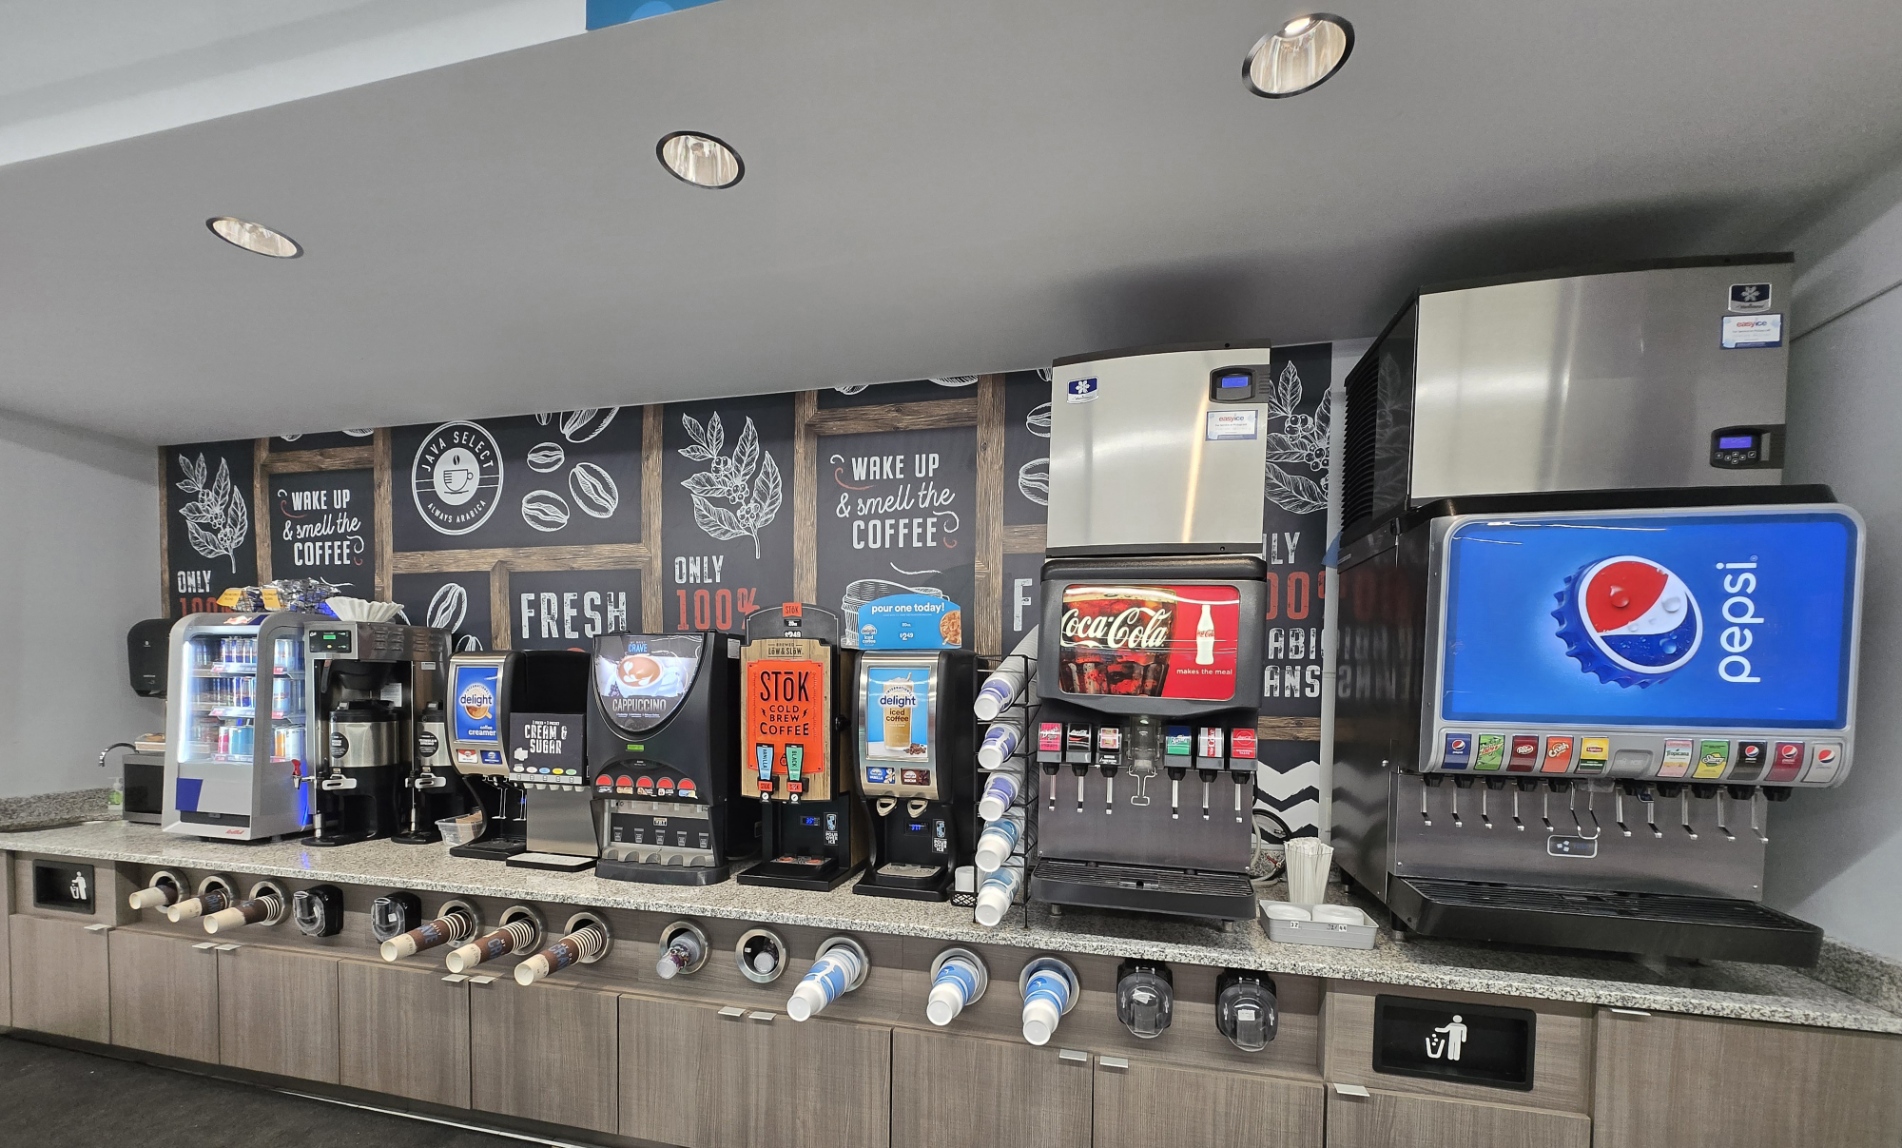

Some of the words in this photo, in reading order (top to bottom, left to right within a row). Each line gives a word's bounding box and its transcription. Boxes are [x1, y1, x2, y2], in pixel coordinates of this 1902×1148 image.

[421, 437, 447, 472] JAVA
[453, 431, 494, 468] SELECT
[851, 455, 905, 481] WAKE
[915, 453, 940, 478] UP
[291, 490, 328, 511] WAKE
[333, 489, 351, 510] UP
[835, 492, 851, 518] &
[857, 483, 915, 516] smell
[917, 480, 956, 509] the
[427, 502, 453, 523] ALWAYS
[456, 500, 487, 523] ARABICA
[282, 520, 293, 541] &
[296, 513, 335, 539] smell
[337, 512, 361, 534] the
[852, 517, 938, 550] COFFEE
[294, 540, 351, 566] COFFEE
[674, 554, 725, 584] ONLY
[177, 569, 212, 594] ONLY
[520, 591, 627, 639] FRESH
[676, 587, 761, 631] 100%
[871, 605, 893, 615] pour
[894, 605, 912, 613] one
[913, 602, 945, 613] today!
[1060, 607, 1173, 649] Coca-Cola
[1715, 561, 1765, 683] pepsi
[628, 643, 648, 653] CRAVE
[1176, 668, 1200, 676] makes
[1214, 668, 1233, 676] meal
[460, 694, 493, 706] delight
[612, 698, 667, 712] CAPPUCCINO
[769, 704, 800, 713] COLD
[879, 695, 917, 708] delight
[769, 714, 800, 723] BREW
[889, 708, 906, 716] iced
[468, 729, 497, 737] creamer
[524, 724, 557, 740] CREAM
[560, 725, 568, 740] &
[760, 721, 810, 736] COFFEE
[529, 738, 562, 754] SUGAR
